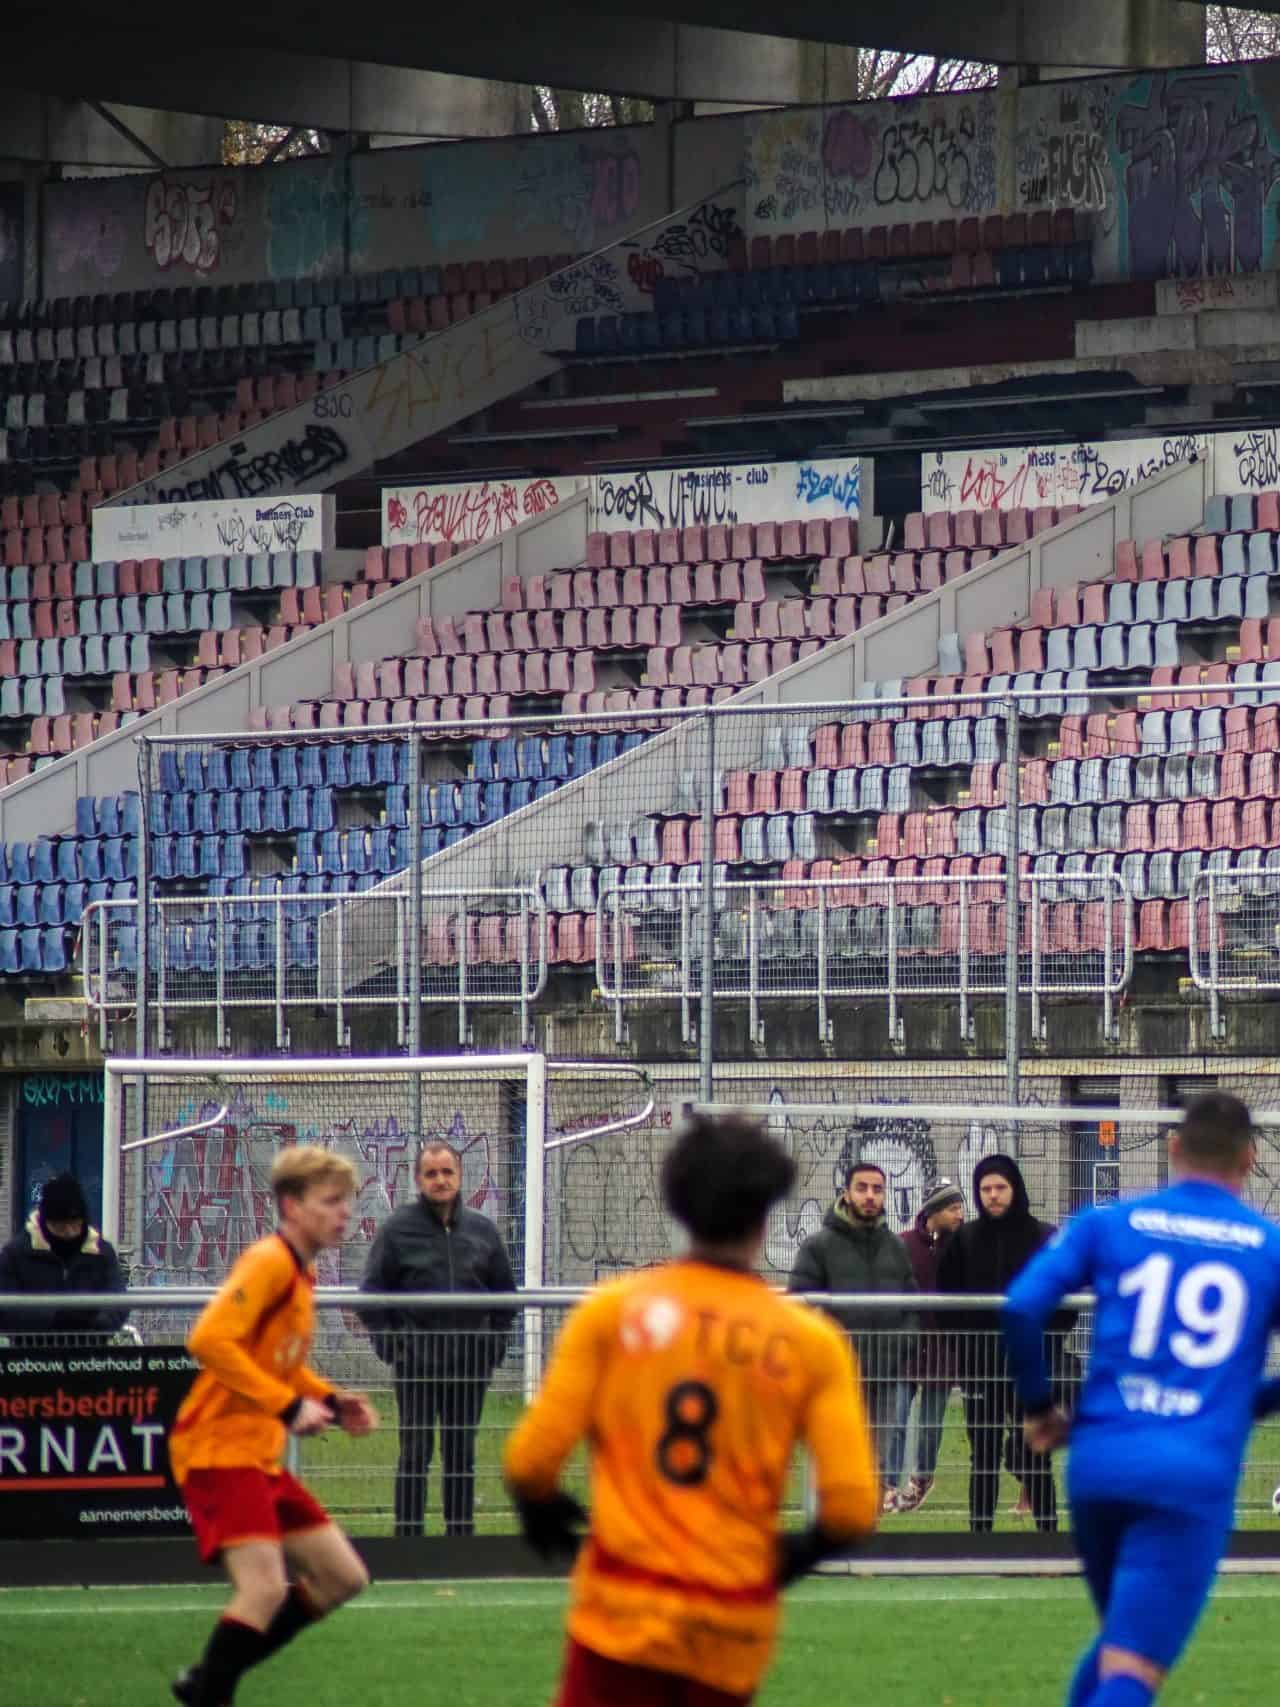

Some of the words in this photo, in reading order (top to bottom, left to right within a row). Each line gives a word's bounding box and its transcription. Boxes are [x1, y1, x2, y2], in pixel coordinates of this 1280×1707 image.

[746, 466, 779, 486] club
[1117, 1252, 1248, 1369] 19
[7, 1357, 65, 1375] opbouw,
[68, 1356, 142, 1372] onderhoud
[148, 1359, 165, 1371] en
[0, 1425, 165, 1473] RNAT
[655, 1380, 720, 1486] 8
